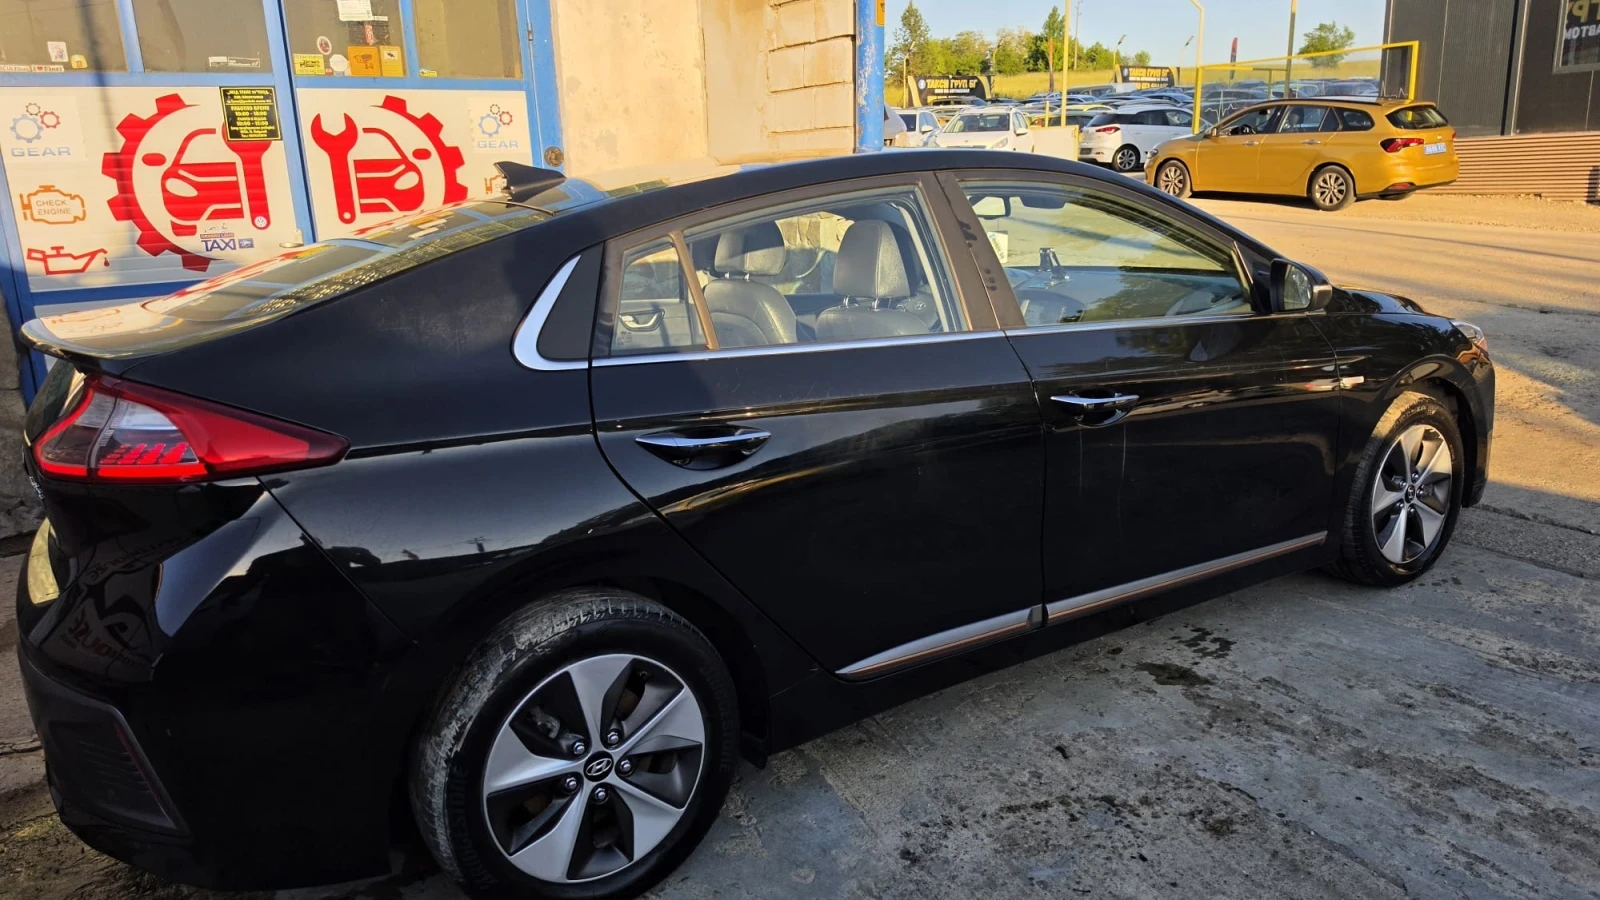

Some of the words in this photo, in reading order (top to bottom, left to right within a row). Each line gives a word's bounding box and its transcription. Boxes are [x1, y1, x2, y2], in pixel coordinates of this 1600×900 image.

[926, 79, 949, 89] ТАКСИ
[950, 79, 968, 89] ГРУП
[969, 79, 978, 89] БГ
[478, 140, 519, 149] GEAR
[11, 146, 71, 157] GEAR
[36, 199, 68, 207] CHECK
[37, 207, 72, 215] ENGINE
[201, 239, 237, 252] TAXI
